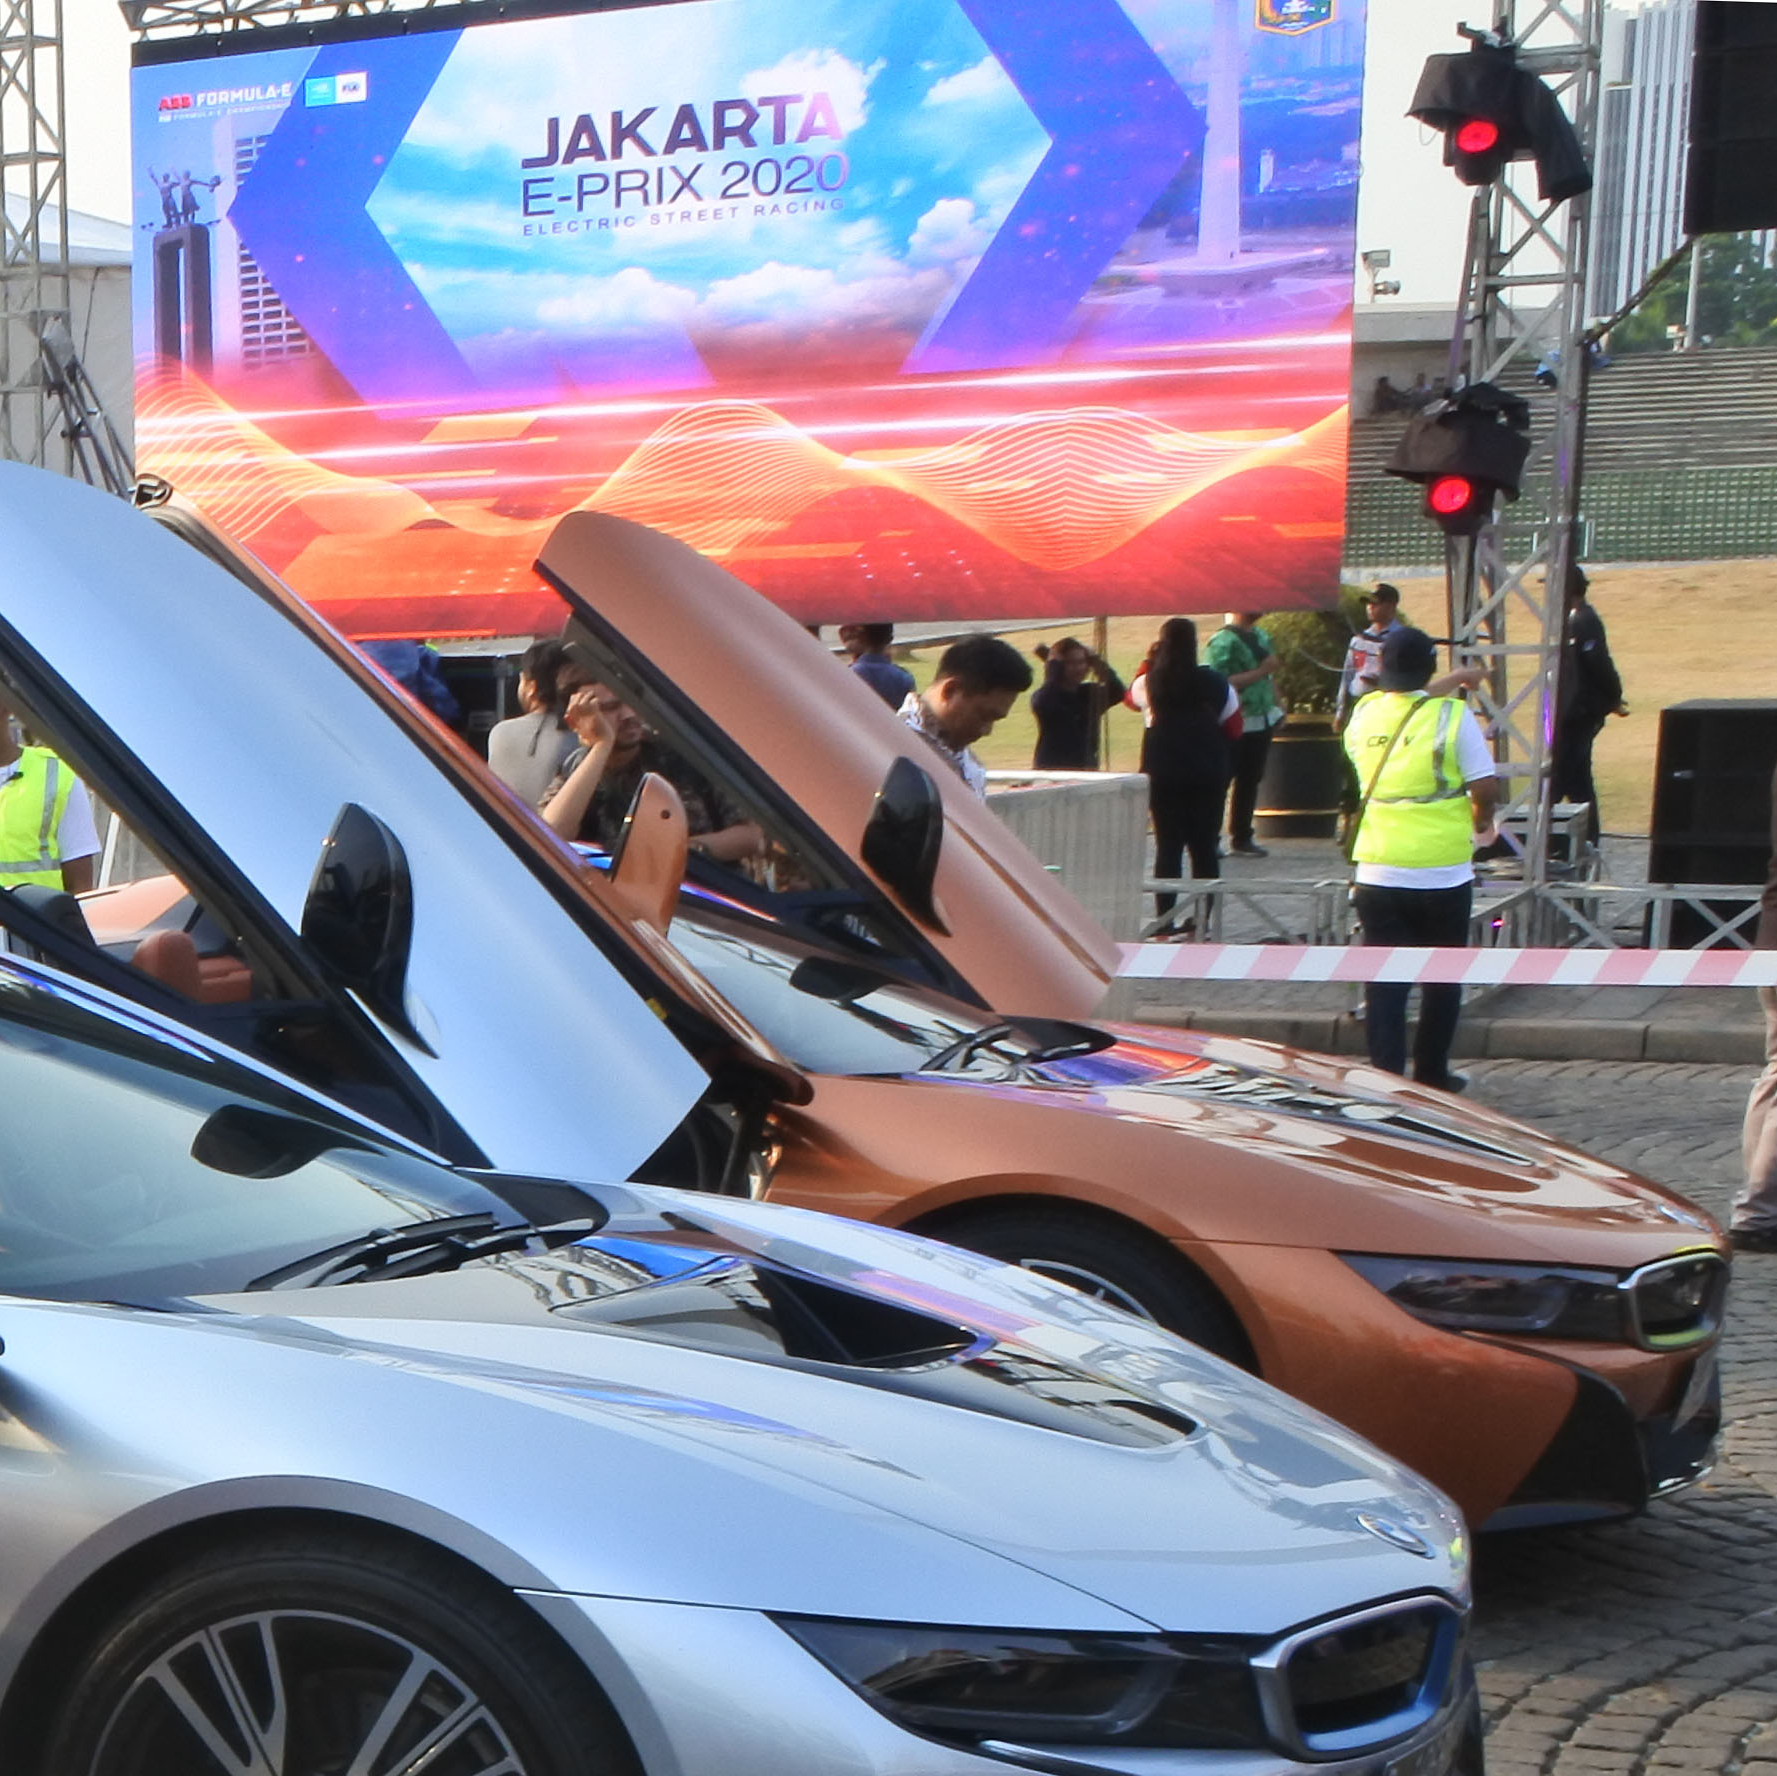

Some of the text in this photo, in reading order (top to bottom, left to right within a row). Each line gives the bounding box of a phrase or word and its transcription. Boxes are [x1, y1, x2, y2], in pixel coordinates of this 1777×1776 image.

[159, 95, 192, 110] ABB
[521, 92, 844, 169] JAKARTA
[523, 152, 849, 217] E-PRIX 2020
[523, 198, 845, 237] ELECTRIC STREET RACING
